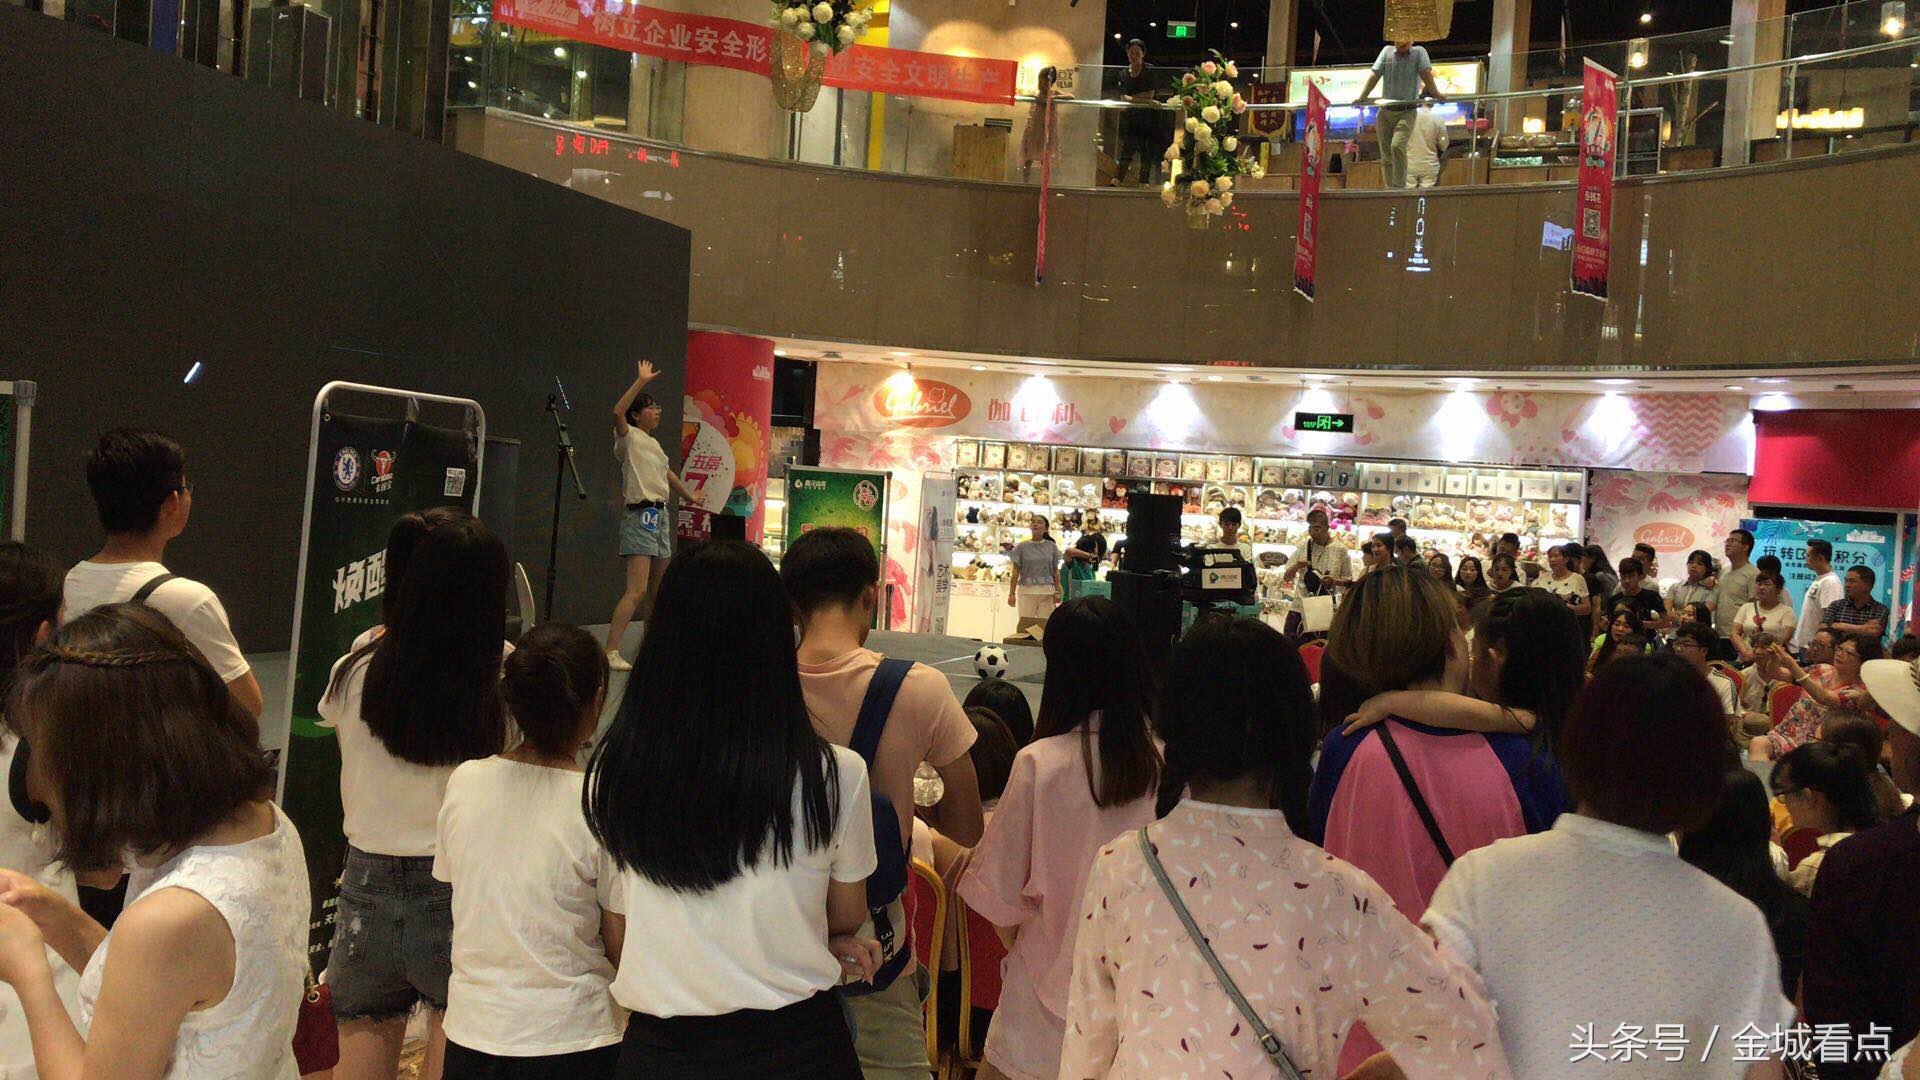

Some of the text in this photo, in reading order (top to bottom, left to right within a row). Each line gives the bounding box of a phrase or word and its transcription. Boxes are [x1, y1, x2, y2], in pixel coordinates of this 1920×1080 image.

[690, 454, 722, 471] 五层
[641, 511, 659, 527] 04
[1641, 529, 1685, 546] Gabriel
